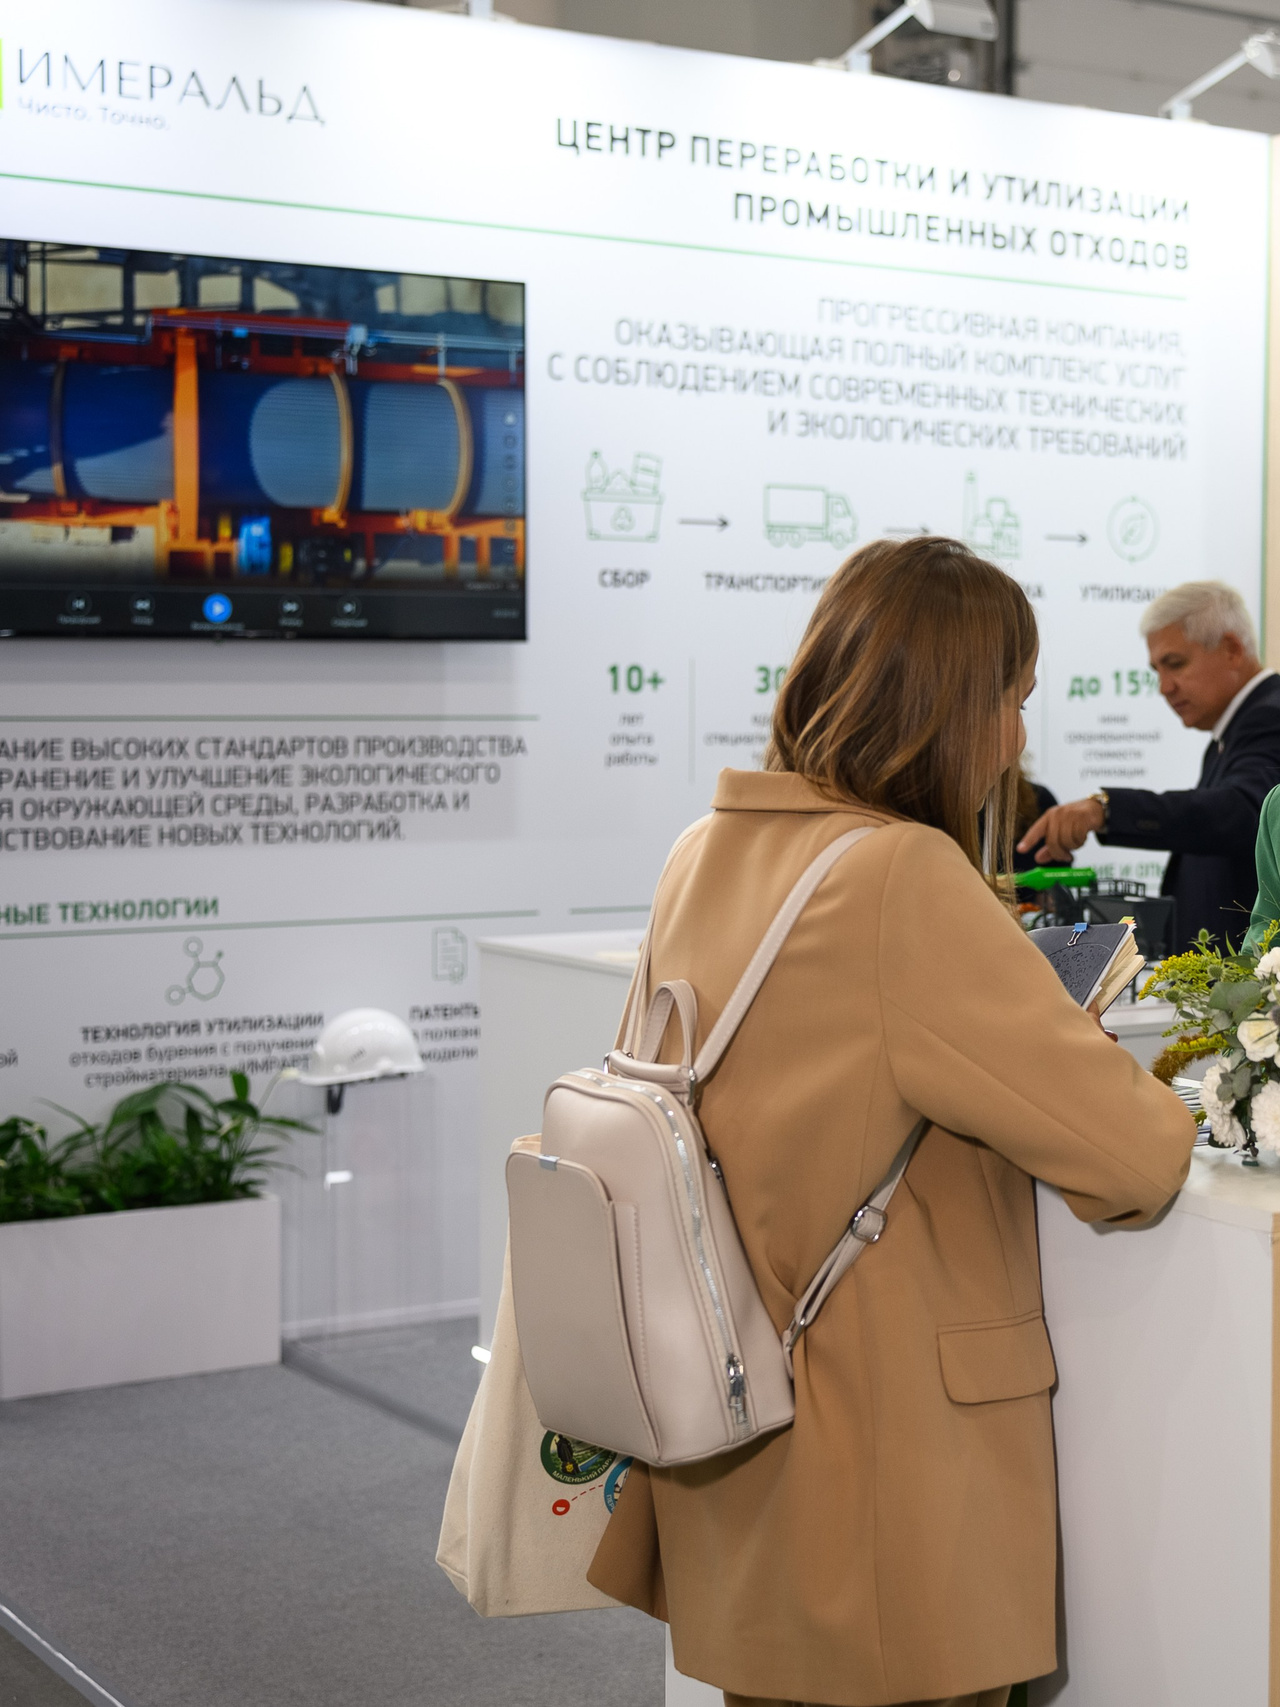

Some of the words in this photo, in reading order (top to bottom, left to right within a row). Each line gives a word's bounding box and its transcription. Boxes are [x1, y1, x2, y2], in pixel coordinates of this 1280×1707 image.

[17, 47, 326, 127] ИМЕРАЛЬД
[18, 95, 91, 122] Чисто.
[556, 117, 676, 160] ЦЕНТР
[690, 135, 936, 192] ПЕРЕРАБОТКИ
[950, 168, 970, 197] И
[982, 171, 1189, 225] УТИЛИЗАЦИИ
[733, 192, 1037, 255] ПРОМЫШЛЕННЫХ
[1049, 229, 1189, 271] ОТХОДОВ
[817, 297, 1040, 341] ПРОГРЕССИВНАЯ
[614, 317, 844, 362] ОКАЗЫВАЮЩАЯ
[851, 338, 967, 373] ПОЛНЫЙ
[974, 350, 1109, 386] КОМПЛЕКС
[1114, 361, 1188, 391] УСЛУГ
[548, 352, 565, 382] С
[573, 354, 800, 398] СОБЛЮДЕНИЕМ
[808, 372, 1009, 414] СОВРЕМЕННЫХ
[1016, 387, 1188, 428] ТЕХНИЧЕСКИХ
[766, 408, 789, 436] И
[795, 410, 1021, 452] ЭКОЛОГИЧЕСКИХ
[1027, 425, 1189, 462] ТРЕБОВАНИЙ
[598, 569, 651, 589] СБОР
[703, 570, 828, 594] ТРАНСПОРТИ
[608, 663, 665, 693] 10+
[1067, 674, 1101, 700] до
[70, 736, 190, 762] ВЫСОКИХ
[194, 735, 350, 761] СТАНДАРТОВ
[353, 734, 528, 760] ПРОИЗВОДСТВА
[122, 766, 141, 791] И
[146, 764, 294, 790] УЛУЧШЕНИЕ
[299, 762, 501, 788] ЭКОЛОГИЧЕСКОГО
[20, 790, 206, 822] ОКРУЖАЮЩЕЙ
[210, 793, 299, 819] СРЕДЫ,
[304, 790, 449, 815] РАЗРАБОТКА
[452, 789, 471, 812] И
[0, 824, 153, 851] СТВОВАНИЕ
[157, 821, 244, 848] НОВЫХ
[250, 814, 406, 845] ТЕХНОЛОГИЙ.
[58, 896, 219, 924] ТЕХНОЛОГИИ
[80, 1018, 201, 1044] ТЕХНОЛОГИЯ
[205, 1011, 324, 1036] УТИЛИЗАЦИИ
[68, 1047, 143, 1068] отходов
[146, 1042, 218, 1064] бурения
[552, 1470, 598, 1484] МАЛЕНЬКИЙ
